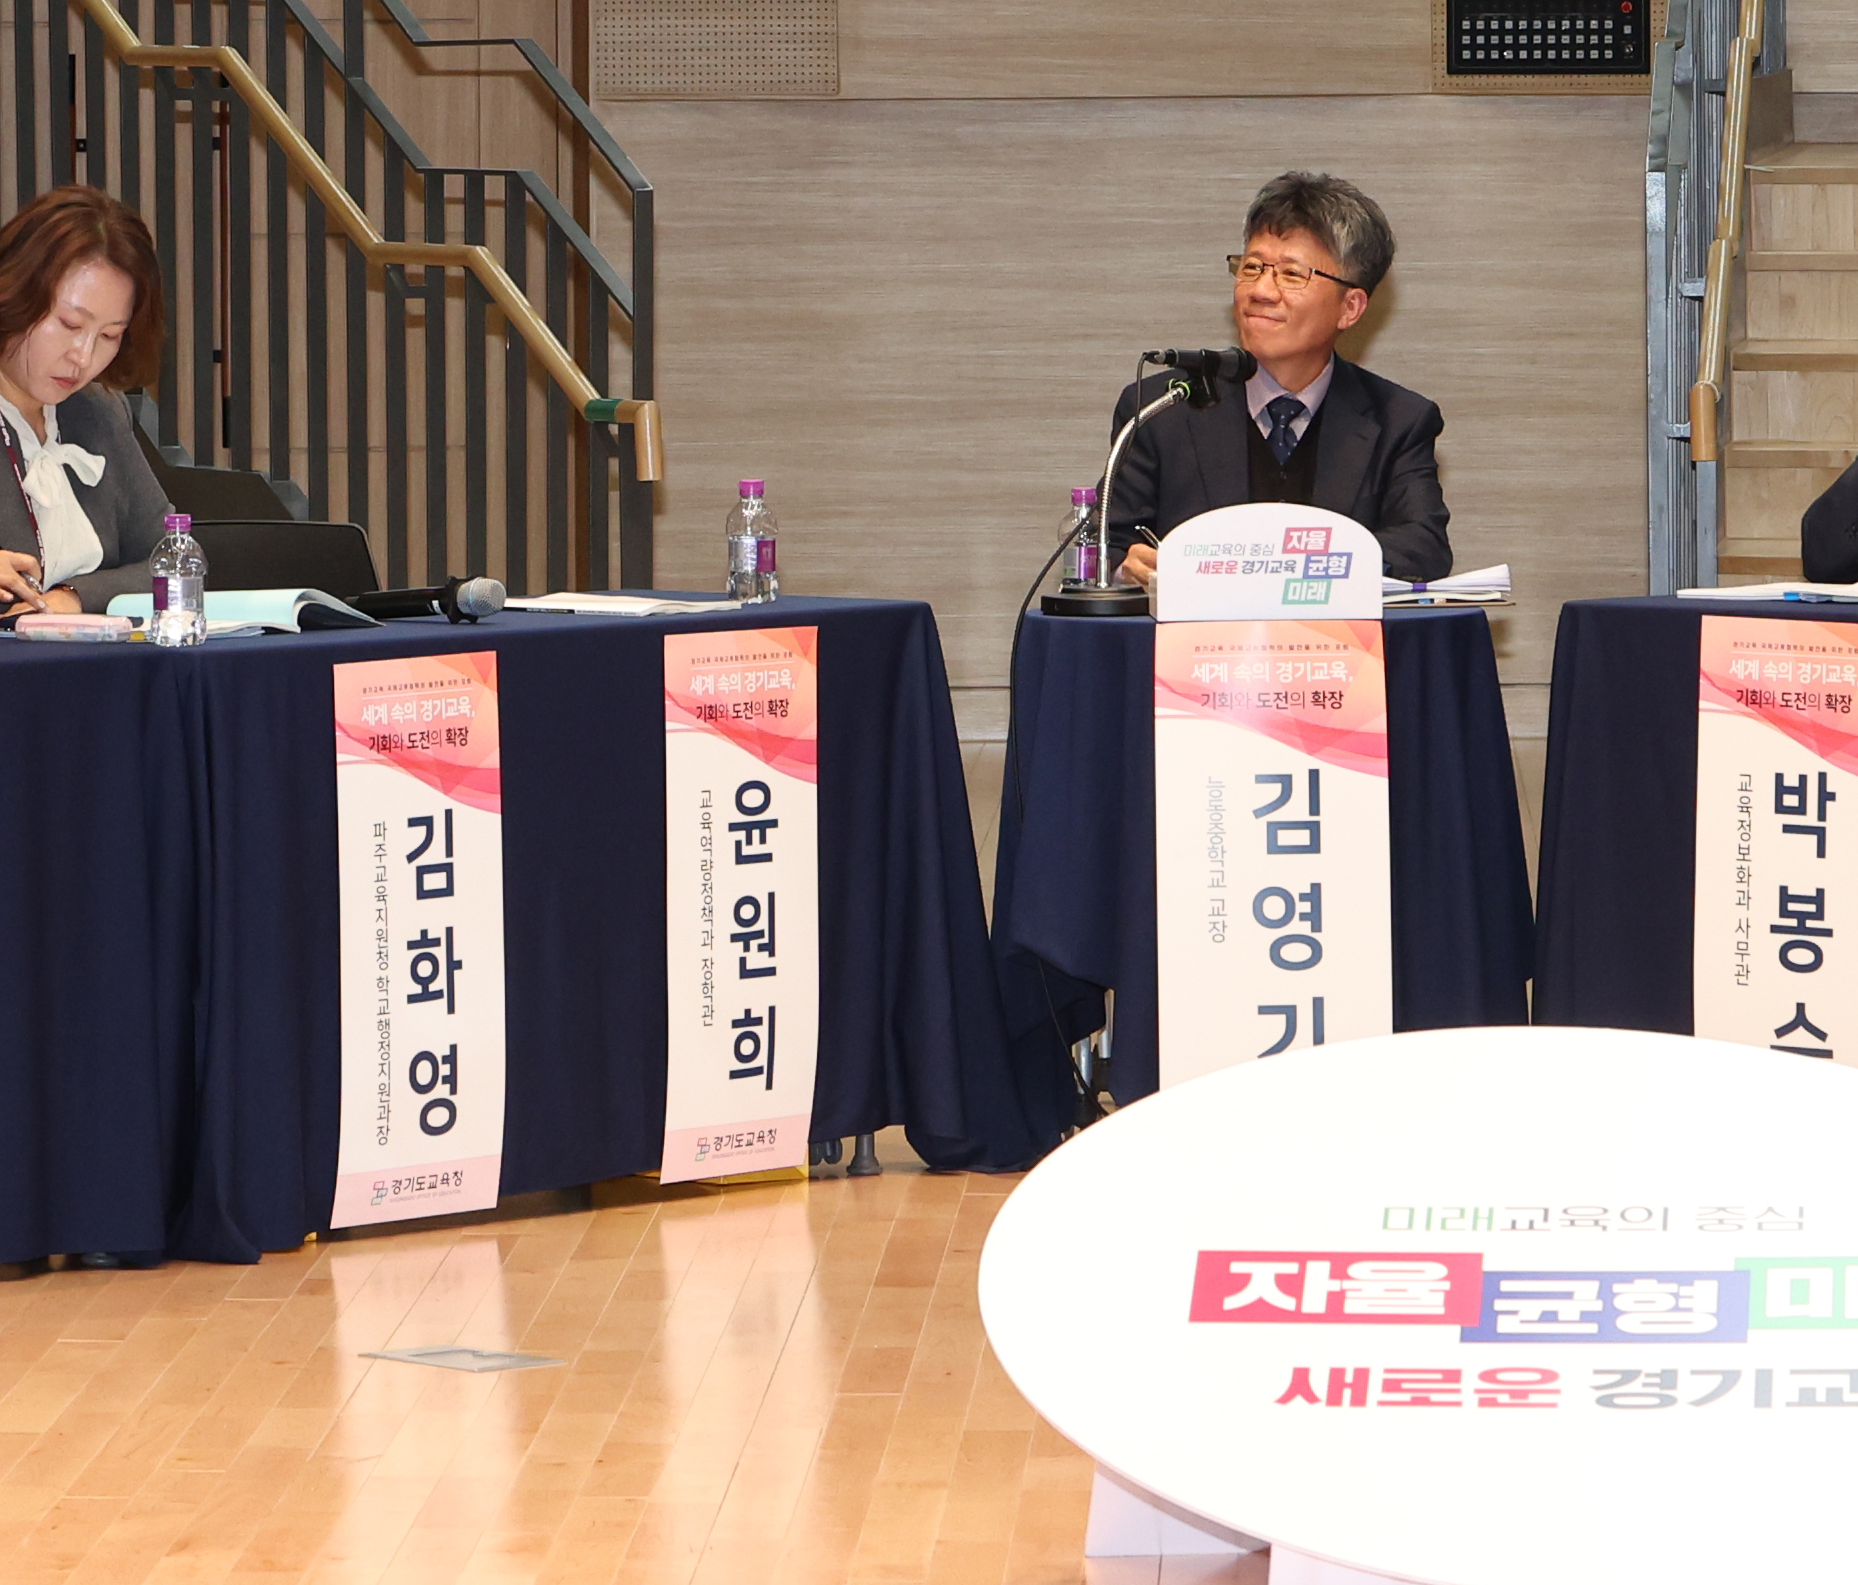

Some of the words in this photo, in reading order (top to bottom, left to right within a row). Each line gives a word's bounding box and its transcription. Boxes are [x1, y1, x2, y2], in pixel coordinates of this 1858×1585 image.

[1183, 542, 1247, 557] 미래교육의
[1249, 542, 1275, 557] 중심
[1286, 530, 1327, 551] 자율
[1195, 559, 1239, 575] 새로운
[1241, 559, 1297, 575] 경기교육
[1307, 555, 1348, 576] 균형
[1287, 581, 1328, 602] 미래
[689, 673, 715, 697] 세계
[716, 671, 742, 695] 속의
[744, 668, 796, 693] 경기교육,
[1190, 661, 1229, 684] 세계
[1232, 661, 1271, 684] 속의
[1275, 660, 1354, 683] 경기교육,
[1728, 658, 1760, 680] 세계
[1762, 660, 1793, 682] 속의
[360, 703, 389, 727] 세계
[390, 700, 418, 724] 속의
[419, 695, 476, 720] 경기교육,
[695, 703, 730, 723] 기회와
[731, 700, 765, 721] 도전의
[767, 698, 790, 719] 확장
[1200, 690, 1252, 711] 기회와
[1257, 690, 1306, 710] 도전의
[1310, 690, 1345, 710] 확장
[1736, 688, 1777, 709] 기회와
[1779, 691, 1821, 711] 도전의
[1824, 692, 1853, 714] 확장
[368, 733, 405, 755] 기회와
[406, 730, 442, 751] 도전의
[445, 726, 470, 748] 확장
[1205, 775, 1228, 889] 능동중학교
[1735, 773, 1754, 911] 교육정보화과
[373, 820, 389, 971] 파주교육지원청
[1207, 898, 1229, 944] 교장
[1252, 768, 1325, 1059] 김영기
[727, 779, 779, 1091] 윤원희
[1734, 917, 1751, 987] 사무관
[405, 808, 463, 1137] 김화영
[701, 956, 715, 1027] 장학관
[713, 1128, 778, 1152] 경기도교육청
[391, 1170, 464, 1196] 경기도교육청
[1380, 1205, 1670, 1234] 미래교육의
[1694, 1204, 1806, 1234] 중심
[1221, 1259, 1452, 1316] 자율
[1492, 1278, 1719, 1335] 균형
[1273, 1365, 1562, 1409] 새로운
